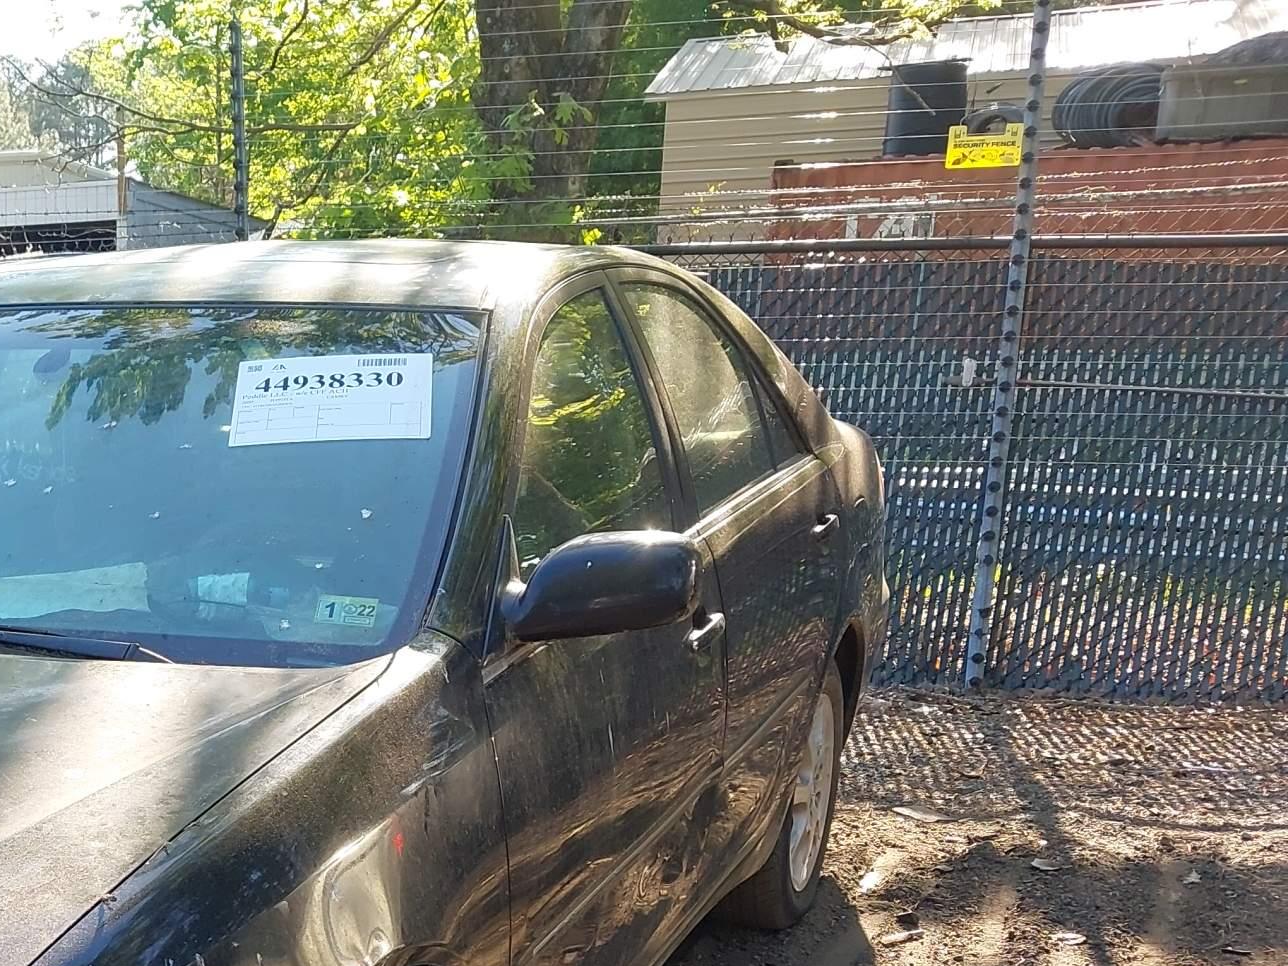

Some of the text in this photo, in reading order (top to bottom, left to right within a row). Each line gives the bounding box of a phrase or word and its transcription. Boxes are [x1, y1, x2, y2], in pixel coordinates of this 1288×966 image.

[255, 371, 404, 393] 44938330
[325, 602, 335, 618] 1
[357, 604, 375, 617] 22
